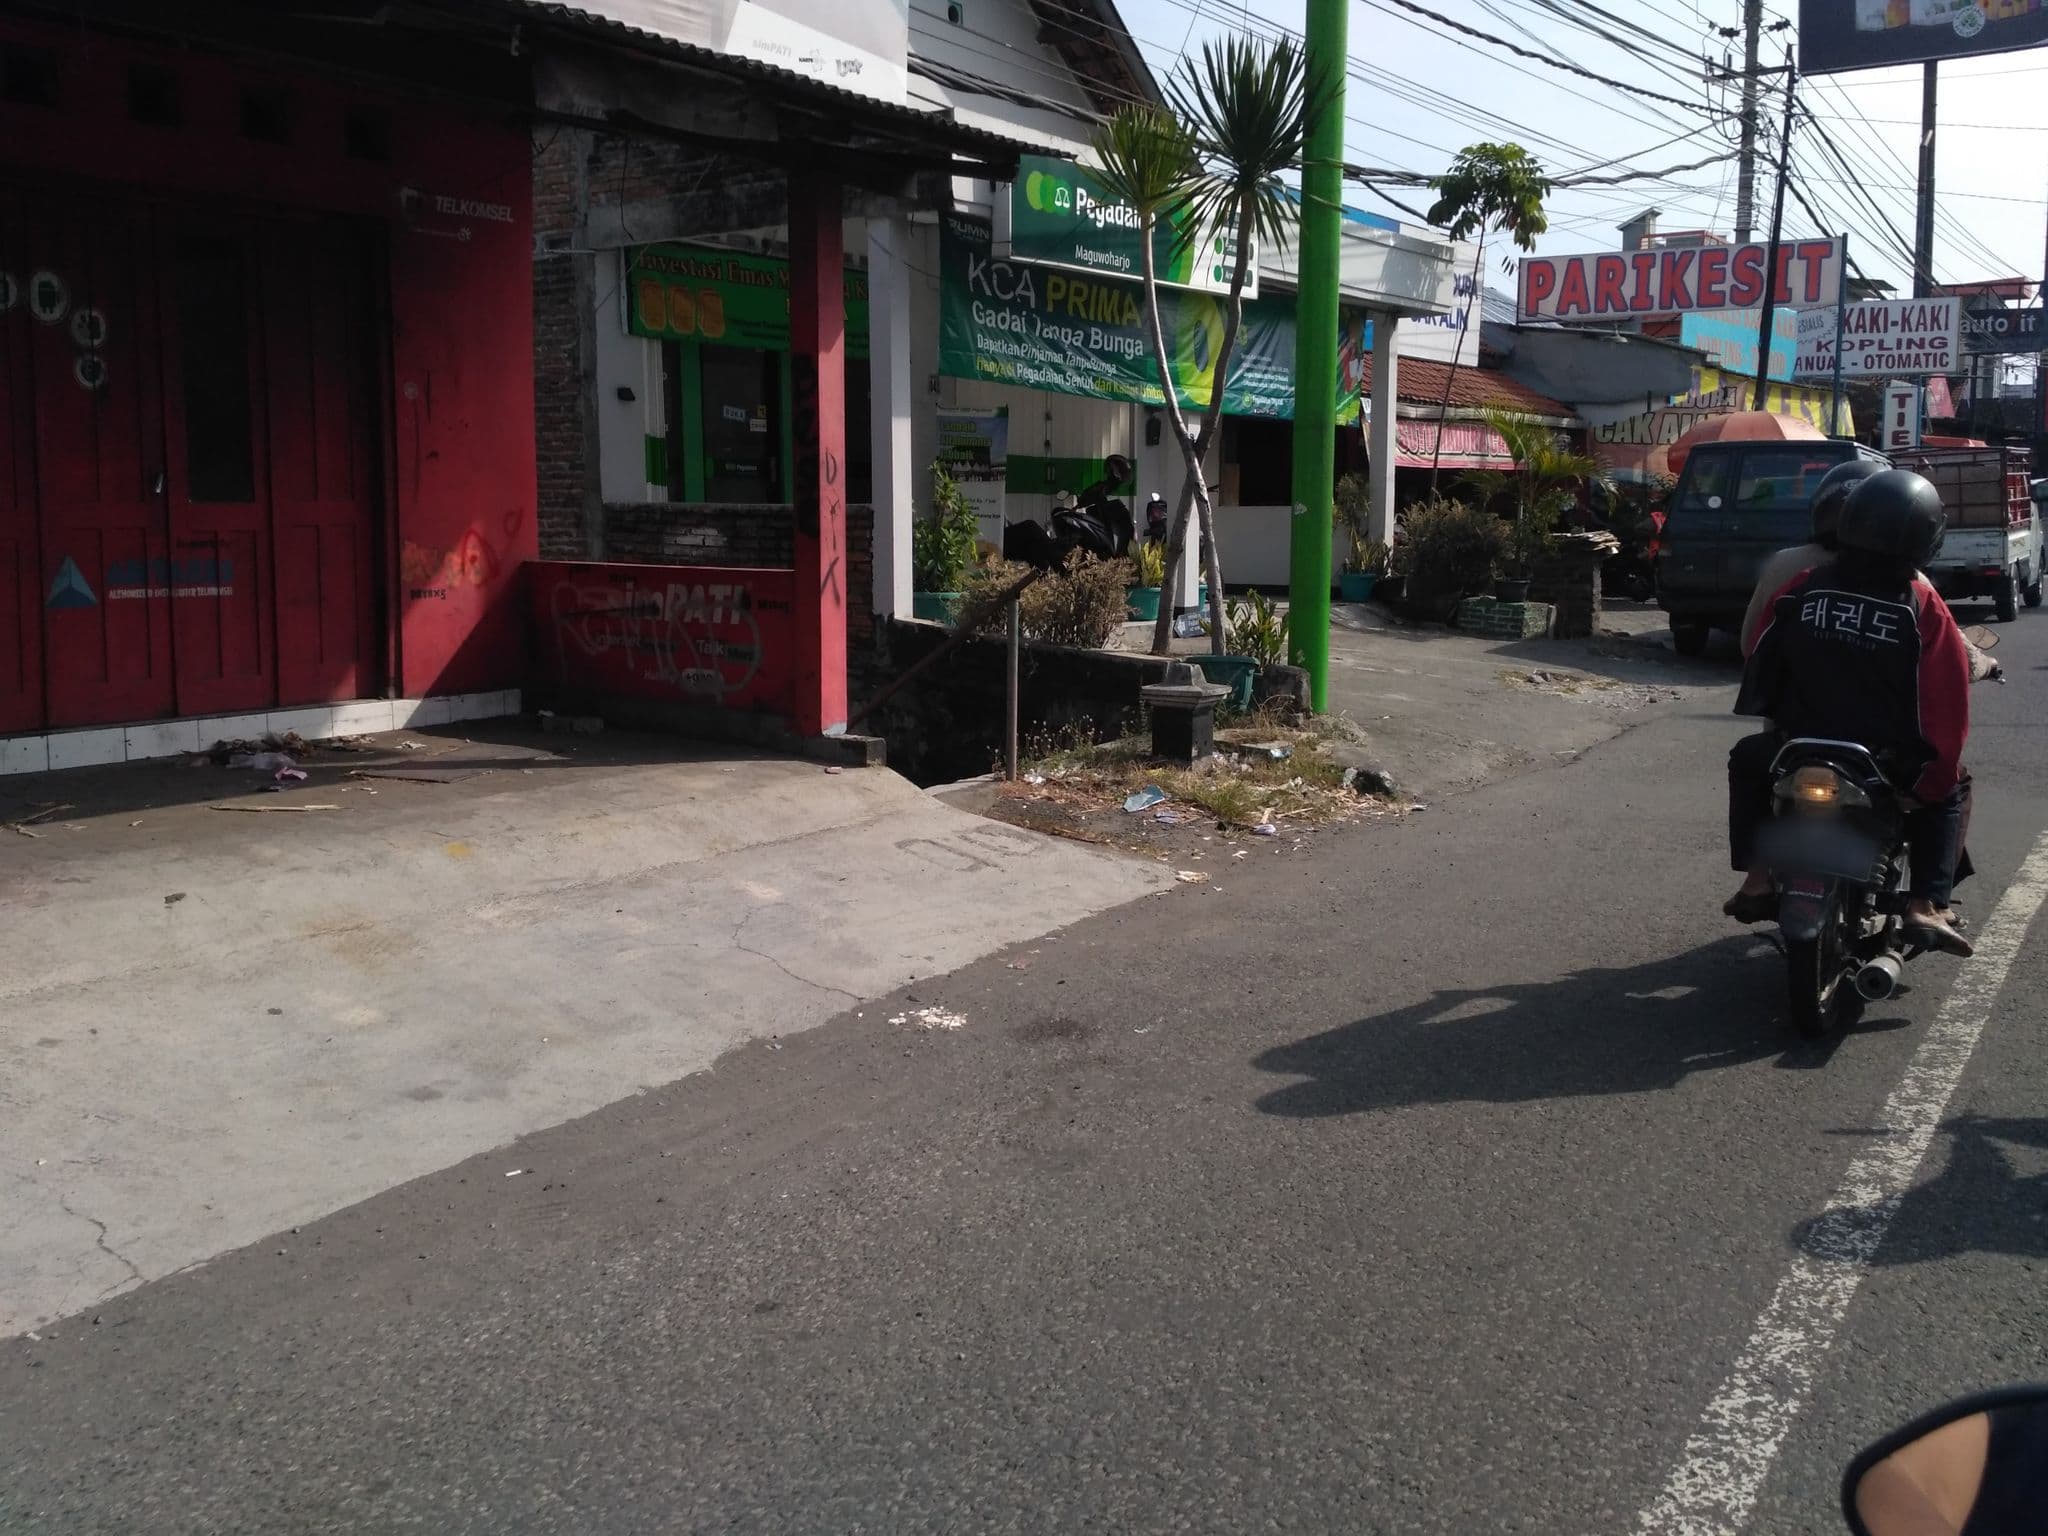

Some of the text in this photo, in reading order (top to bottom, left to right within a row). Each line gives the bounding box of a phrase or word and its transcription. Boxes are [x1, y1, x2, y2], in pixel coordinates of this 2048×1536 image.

[434, 195, 514, 224] TELKOMSEL
[638, 252, 723, 281] Investasi
[727, 261, 774, 288] Emas
[1075, 244, 1131, 272] Maguwoharjo
[968, 252, 1142, 329] KCA PRIMA
[1525, 239, 1834, 318] PARIKESIT
[972, 299, 1027, 334] Gadai
[1089, 326, 1145, 360] Bunga
[1843, 303, 1950, 334] KAKI-KAKI
[1961, 313, 2037, 333] auto it
[1021, 343, 1064, 364] Pinjaman
[1816, 336, 1949, 353] KOPLING
[1863, 352, 1950, 370] OTOMATIC
[1016, 362, 1065, 384] Pegadaian
[1094, 375, 1113, 392] dan
[1594, 411, 1656, 445] CAK
[1800, 597, 1899, 644] 태권도
